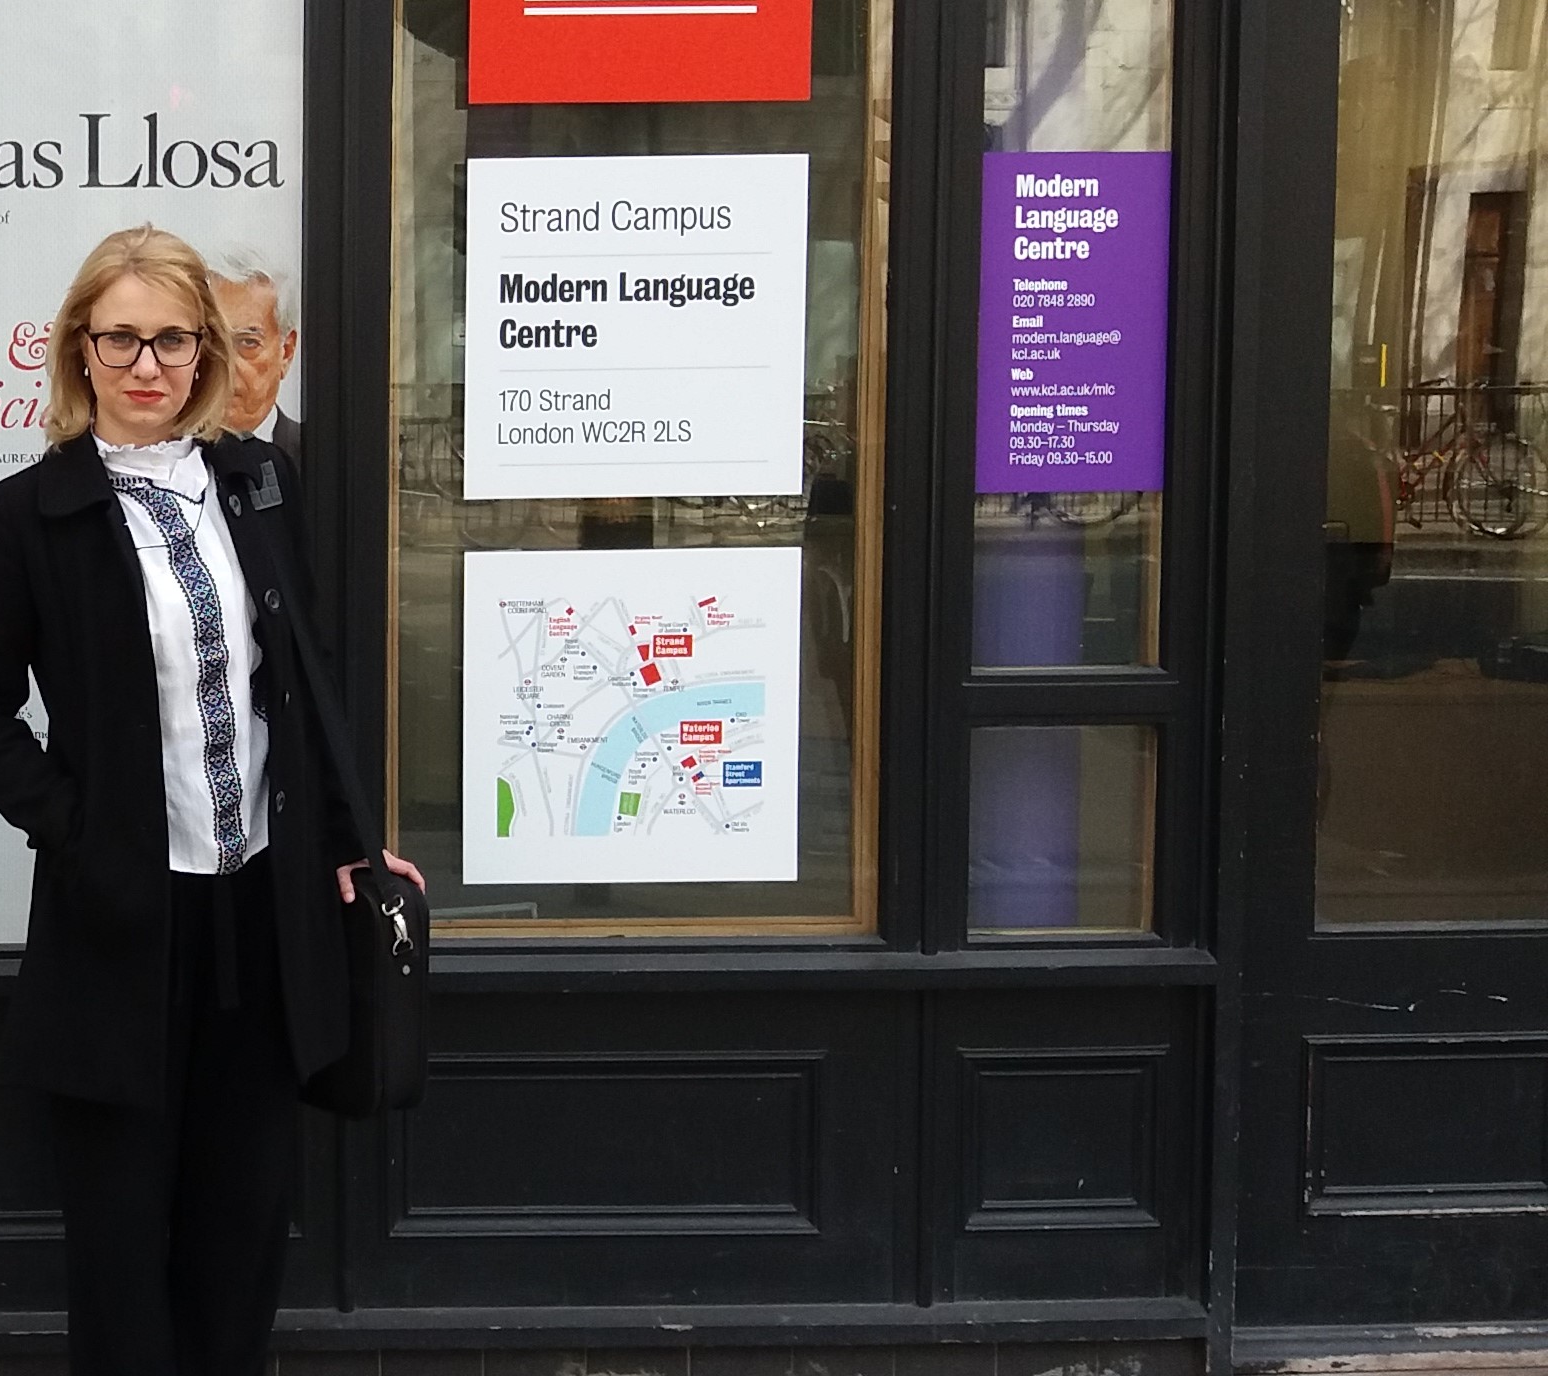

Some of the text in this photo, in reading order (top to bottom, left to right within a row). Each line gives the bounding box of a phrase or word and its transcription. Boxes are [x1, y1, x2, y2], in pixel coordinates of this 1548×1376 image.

[78, 112, 285, 190] Llosa
[1015, 173, 1099, 198] Modern
[500, 200, 732, 236] Strand Campus
[1015, 205, 1119, 233] Language
[1014, 236, 1090, 260] Centre
[499, 272, 755, 307] Modern Language
[1012, 279, 1068, 293] Telephone
[1012, 294, 1095, 308] 020 7848 2890
[1012, 315, 1044, 328] Email
[499, 318, 598, 349] Centre
[1012, 330, 1121, 345] modern.language@
[1011, 347, 1061, 360] kcl.ac.uk
[1011, 368, 1034, 381] Web
[1011, 383, 1116, 396] www.kcl.ac.uk/mlc
[498, 388, 611, 411] 170 Strand
[1010, 404, 1088, 419] Opening times
[497, 420, 692, 445] London WC2R 2LS
[1010, 421, 1054, 435] Monday
[1067, 420, 1119, 433] Thursday
[1009, 452, 1045, 466] Friday
[655, 637, 685, 645] Strand
[655, 646, 688, 655] Campus
[682, 724, 720, 732] Waterloo
[682, 733, 714, 742] Campus
